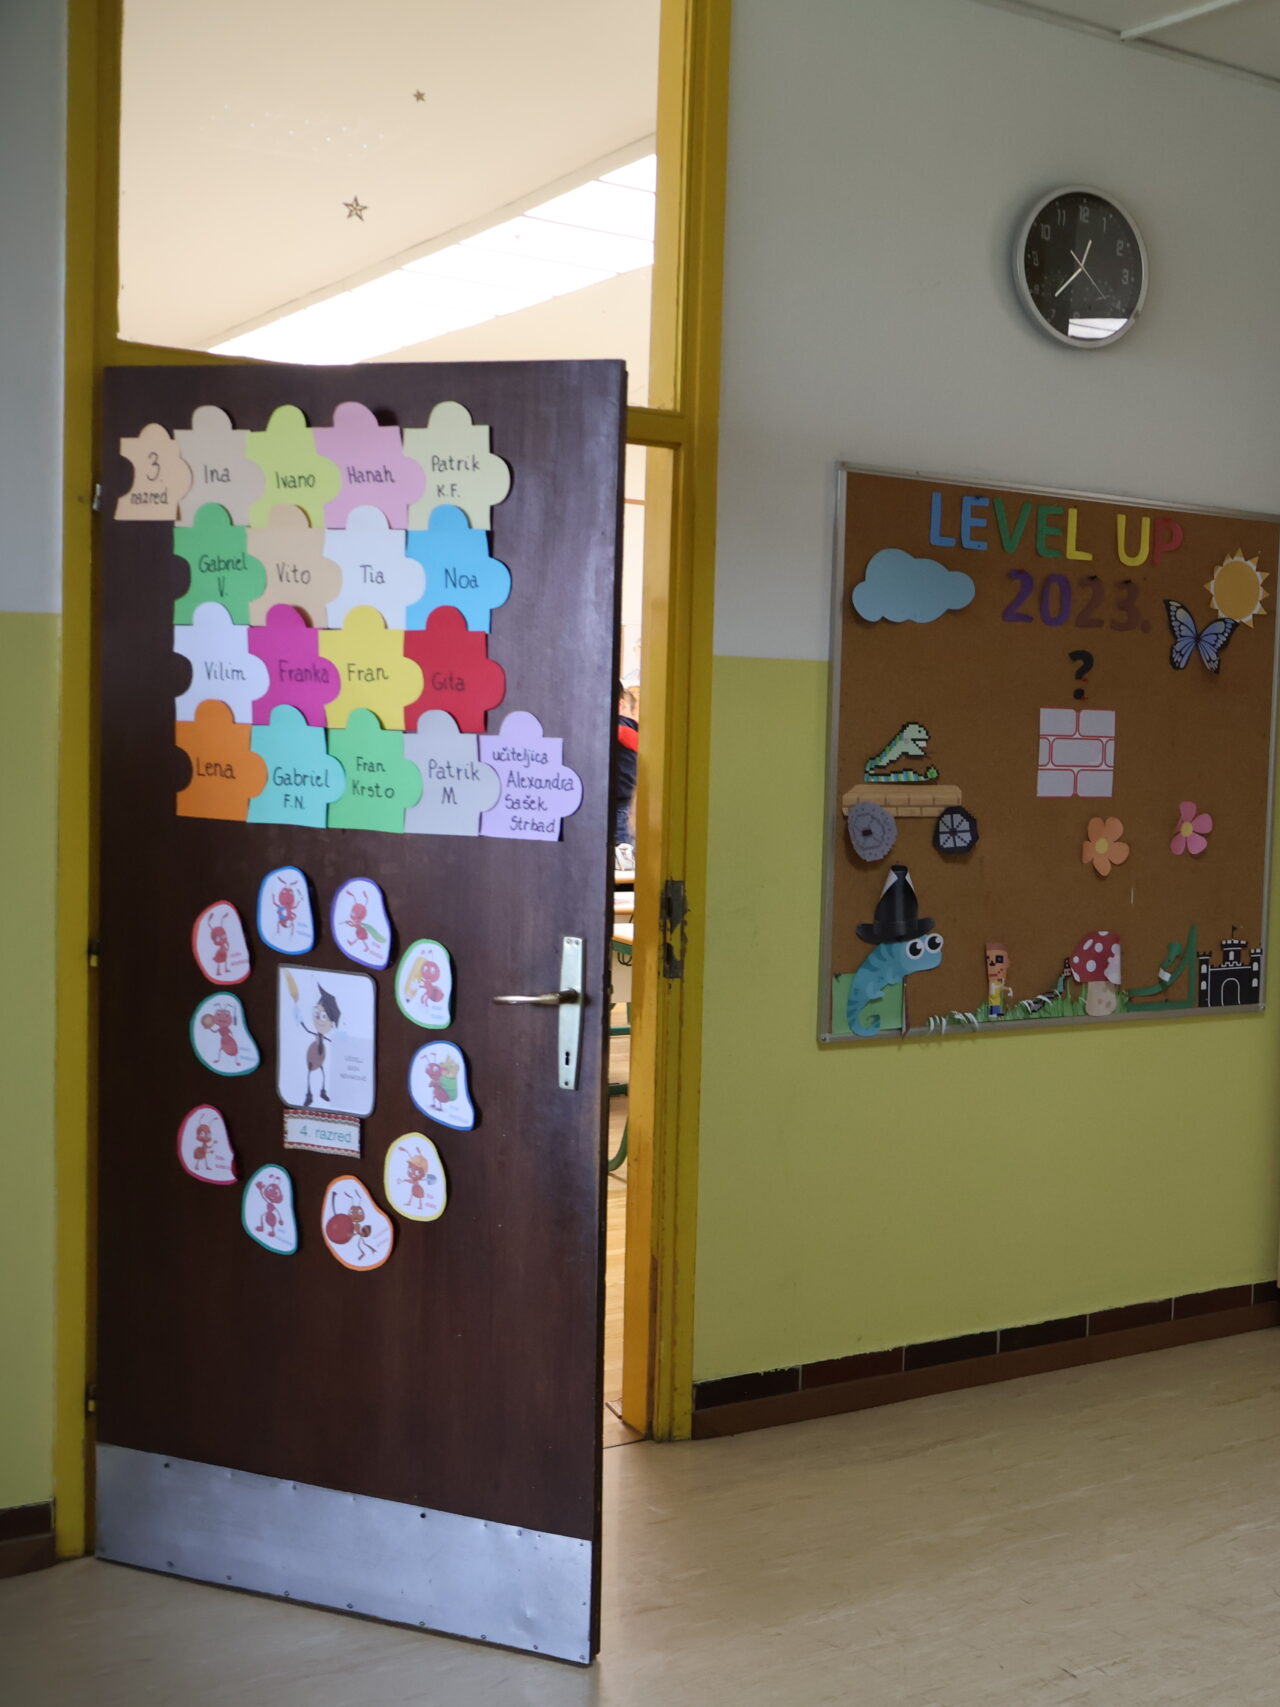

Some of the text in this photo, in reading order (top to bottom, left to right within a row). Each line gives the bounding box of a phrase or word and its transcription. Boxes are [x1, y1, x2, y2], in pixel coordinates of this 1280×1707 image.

[1057, 209, 1066, 227] 11
[1079, 206, 1090, 224] 12
[1102, 217, 1107, 233] 1
[1041, 224, 1050, 241] 10
[1116, 240, 1124, 256] 2
[1121, 269, 1129, 285] 3
[431, 455, 480, 473] Patrik
[204, 465, 231, 484] Ina
[275, 471, 316, 489] Ivano
[347, 465, 395, 485] Hanah
[929, 492, 1183, 568] LEVEL UP
[198, 552, 248, 573] Gabriel
[277, 562, 311, 584] Vito
[360, 565, 386, 585] Tia
[444, 568, 479, 589] Noa
[1002, 569, 1152, 634] 2023.
[204, 662, 247, 682] Vilim
[279, 662, 330, 684] Franka
[347, 663, 389, 682] Fran
[1068, 649, 1094, 701] ?
[431, 672, 465, 693] Gita
[356, 757, 386, 773] Fran
[492, 747, 549, 768] učiteljica
[196, 761, 236, 780] Lena
[273, 767, 330, 789] Gabriel
[429, 759, 480, 782] Patrik
[506, 770, 574, 791] Alexandra
[352, 779, 394, 799] Krsto
[442, 787, 457, 805] M
[504, 794, 548, 811] Sašek
[299, 1124, 352, 1144] 4. razred
